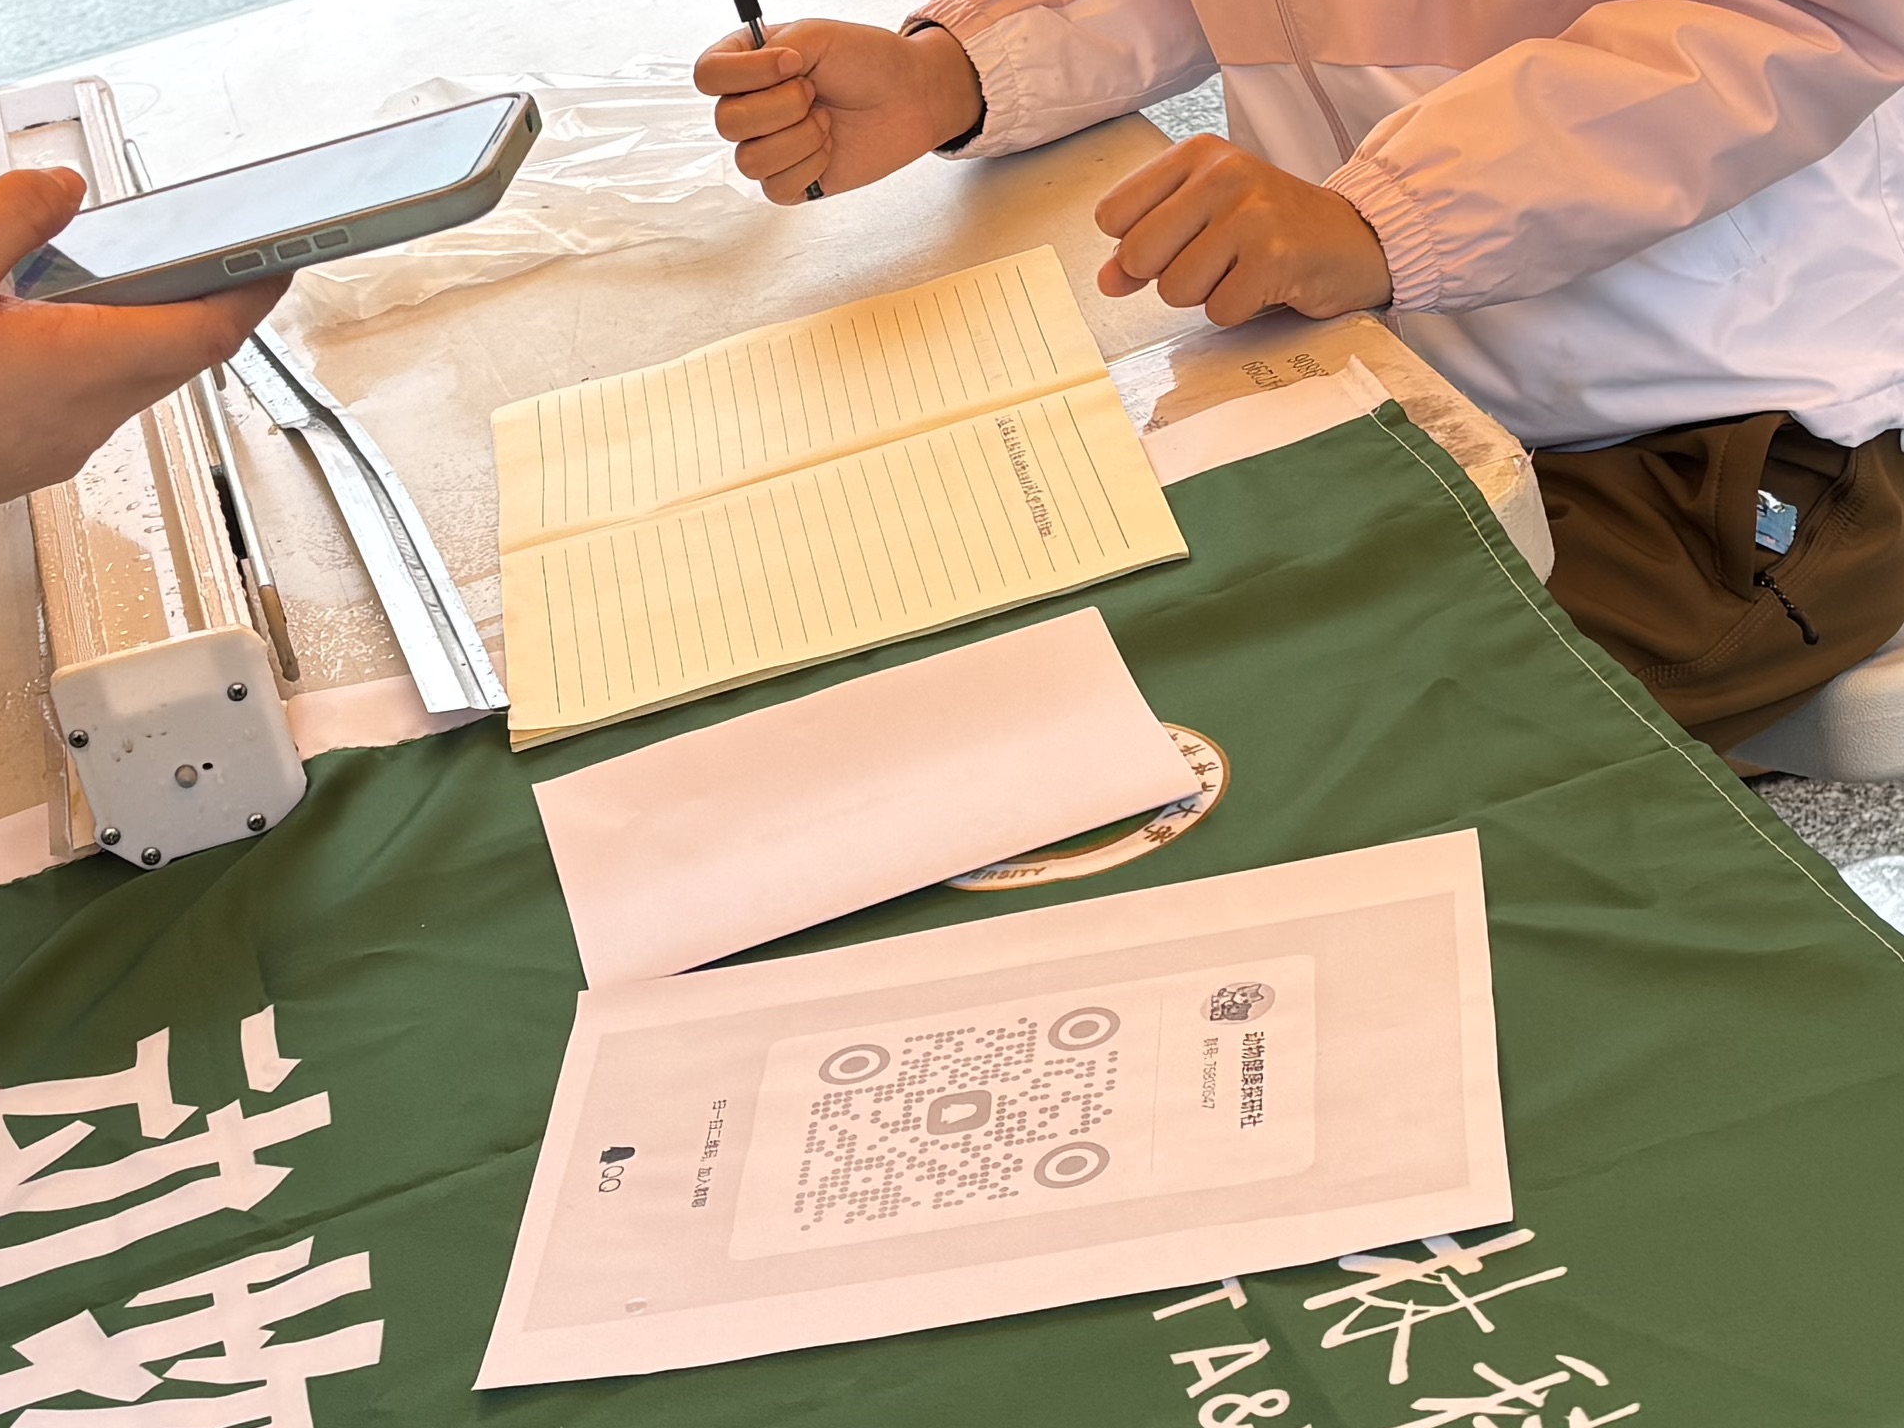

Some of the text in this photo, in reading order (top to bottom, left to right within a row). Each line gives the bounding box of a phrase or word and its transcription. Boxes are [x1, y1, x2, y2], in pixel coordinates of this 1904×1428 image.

[1240, 1031, 1266, 1129] 动物健康探研社
[598, 1165, 625, 1193] QQ
